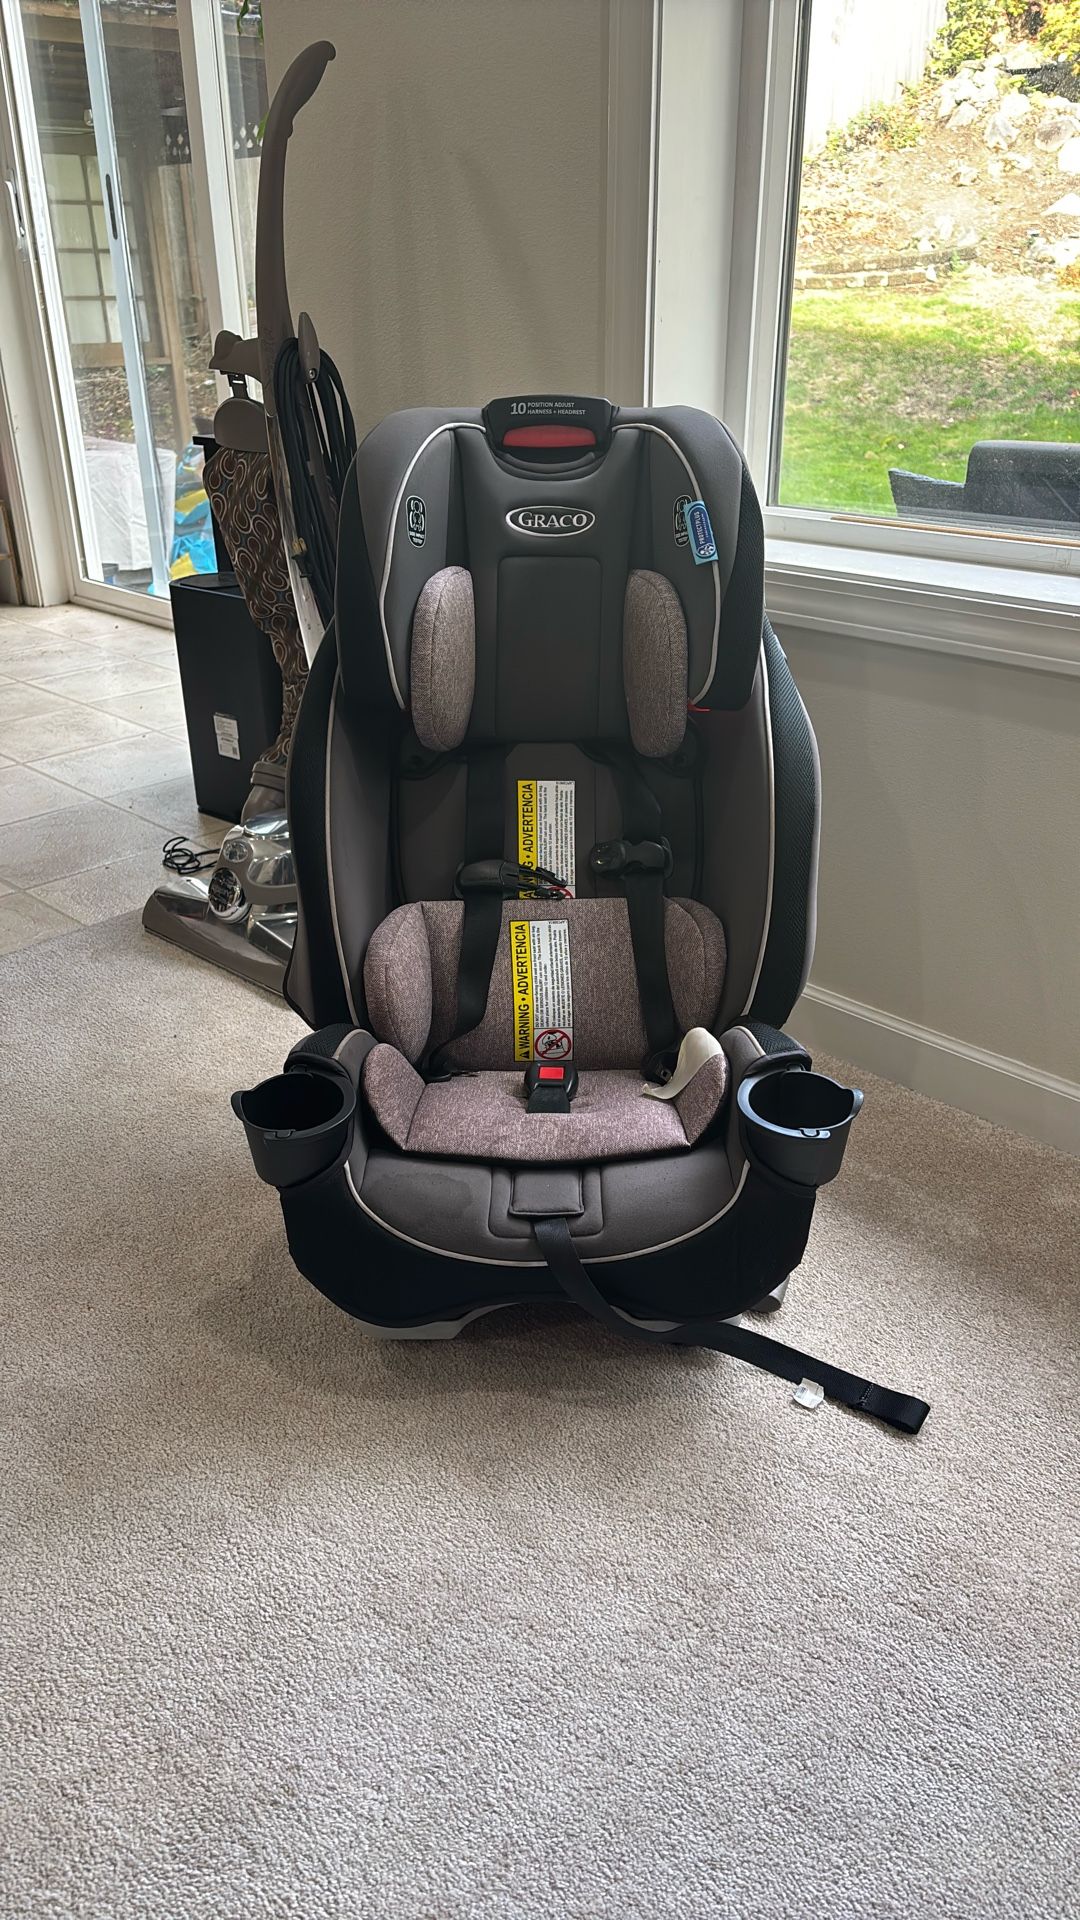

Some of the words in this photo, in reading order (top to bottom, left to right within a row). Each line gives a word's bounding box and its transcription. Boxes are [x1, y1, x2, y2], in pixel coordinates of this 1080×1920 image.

[510, 402, 526, 415] 10
[518, 512, 588, 528] GRACO
[522, 784, 534, 852] ADVERTENCIA
[515, 924, 528, 995] ADVERTENCIA
[518, 1004, 530, 1050] WARNING
